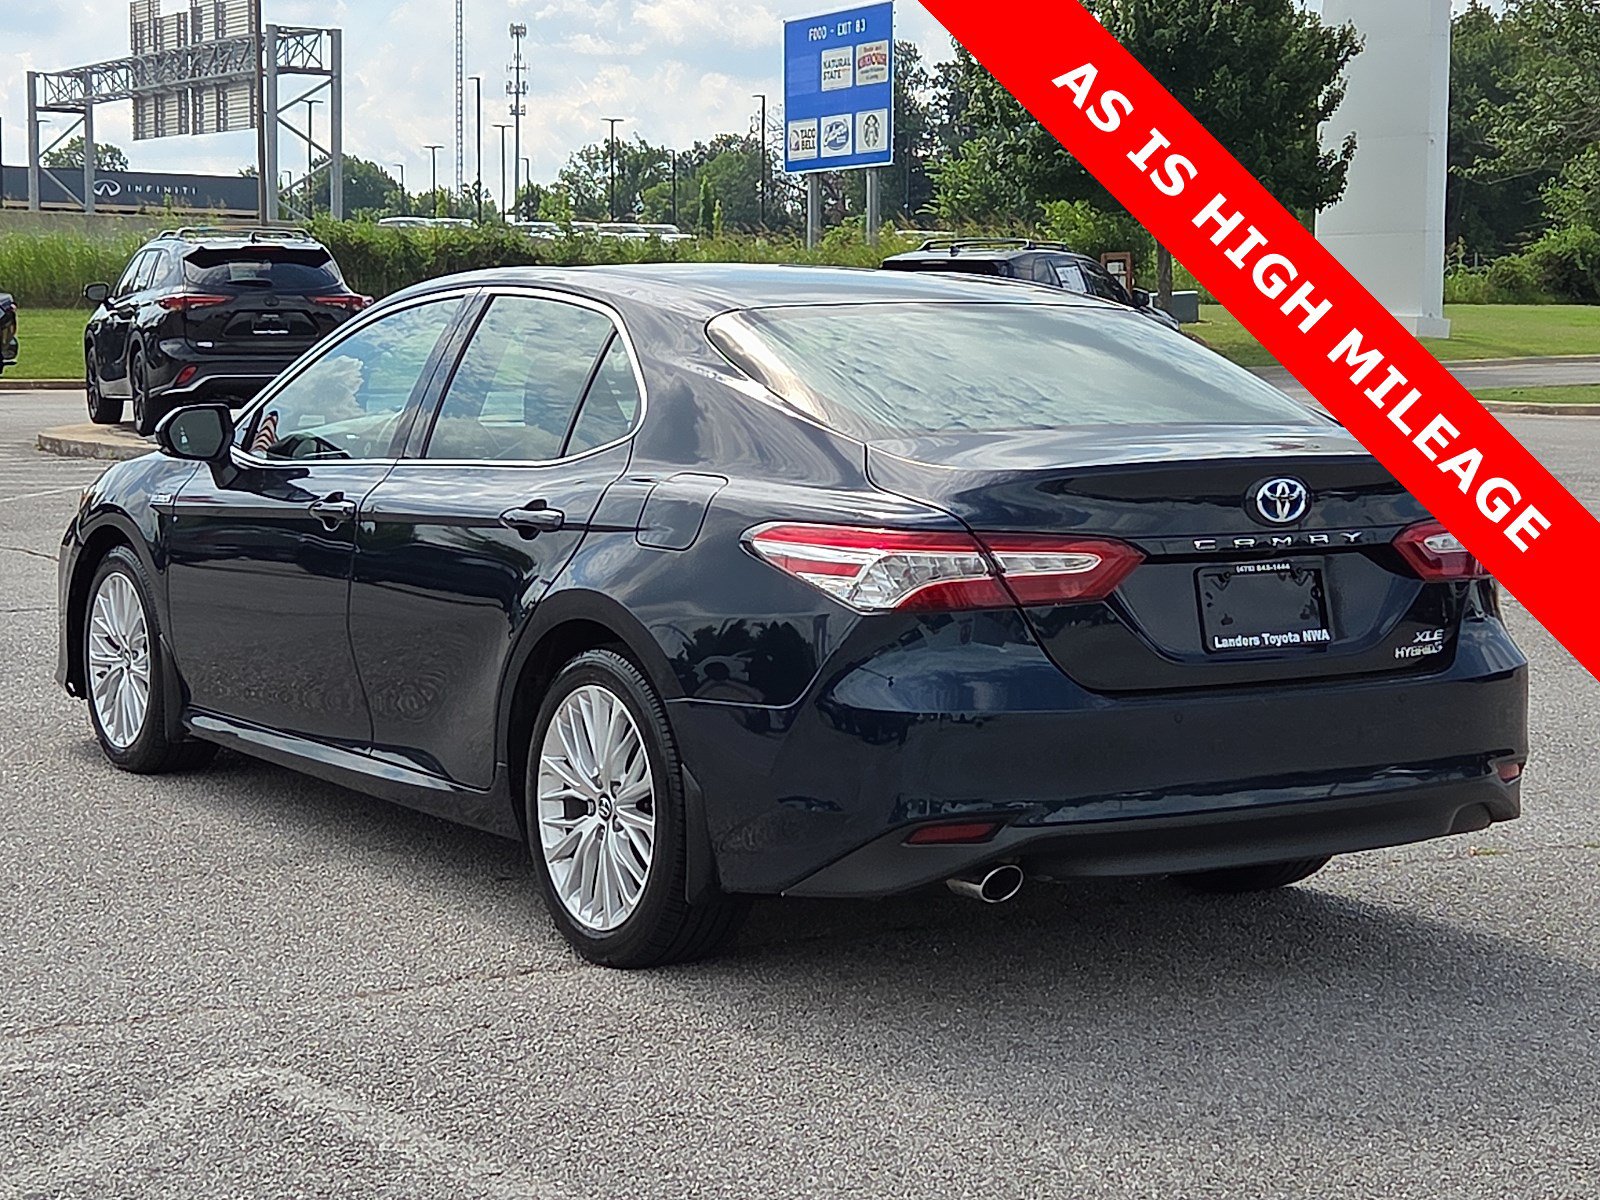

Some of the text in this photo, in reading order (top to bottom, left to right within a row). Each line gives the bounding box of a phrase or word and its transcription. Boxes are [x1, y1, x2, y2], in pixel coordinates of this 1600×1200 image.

[808, 25, 827, 42] FOOD
[837, 20, 852, 36] EXIT
[823, 57, 852, 69] NATURAL
[823, 69, 842, 81] STATE
[801, 139, 816, 151] BELL
[127, 184, 196, 195] INFINITI
[1193, 531, 1362, 550] CAMRY
[1214, 629, 1331, 649] Landers Toyota NWA
[1412, 629, 1444, 643] XLE
[1394, 643, 1438, 659] HYBRID
